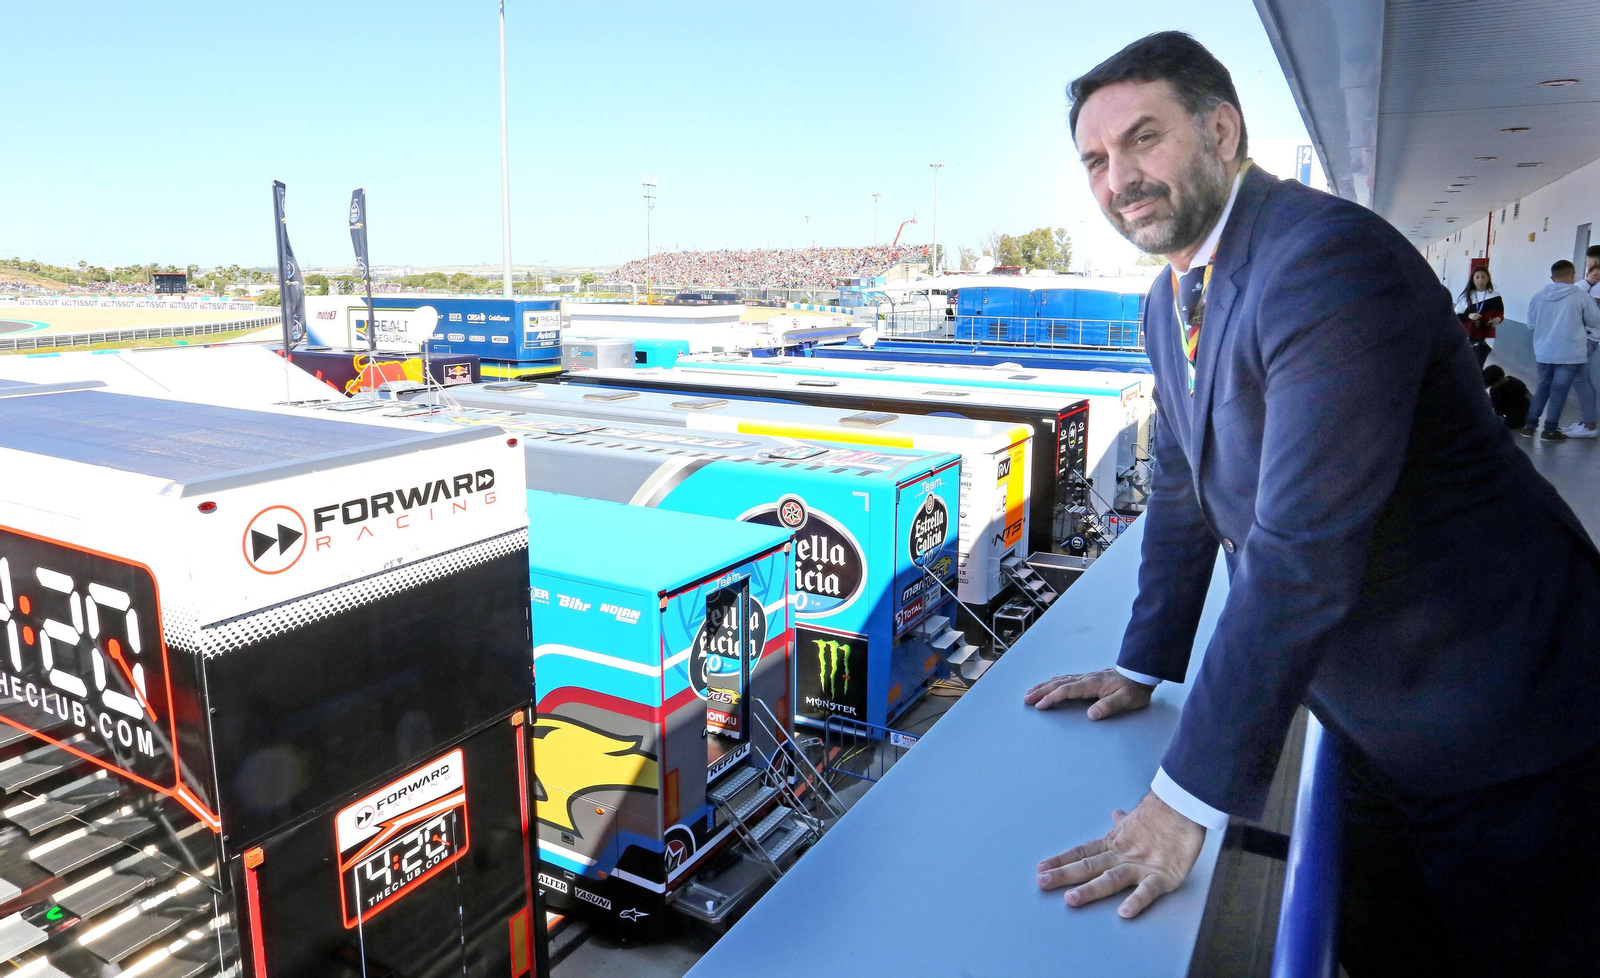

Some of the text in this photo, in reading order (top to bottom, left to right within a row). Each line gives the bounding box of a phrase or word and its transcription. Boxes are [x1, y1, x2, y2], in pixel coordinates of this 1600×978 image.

[208, 302, 228, 310] TISSOT
[917, 478, 944, 496] Team
[314, 468, 495, 532] FORWARD
[316, 491, 497, 551] RACING
[915, 510, 944, 538] Estrella
[796, 534, 846, 567] ella
[709, 572, 748, 593] Team
[795, 560, 841, 596] icia
[556, 593, 591, 612] Bihr
[599, 602, 641, 624] NOLAN
[903, 602, 922, 620] TOTAL
[805, 696, 857, 716] MONSTER
[376, 764, 450, 811] FORWARD
[377, 774, 451, 817] RACING
[366, 816, 449, 886] 4:20
[368, 849, 449, 906] THECLUB.COM
[538, 874, 567, 892] ALFER
[574, 887, 611, 909] YASUNI
